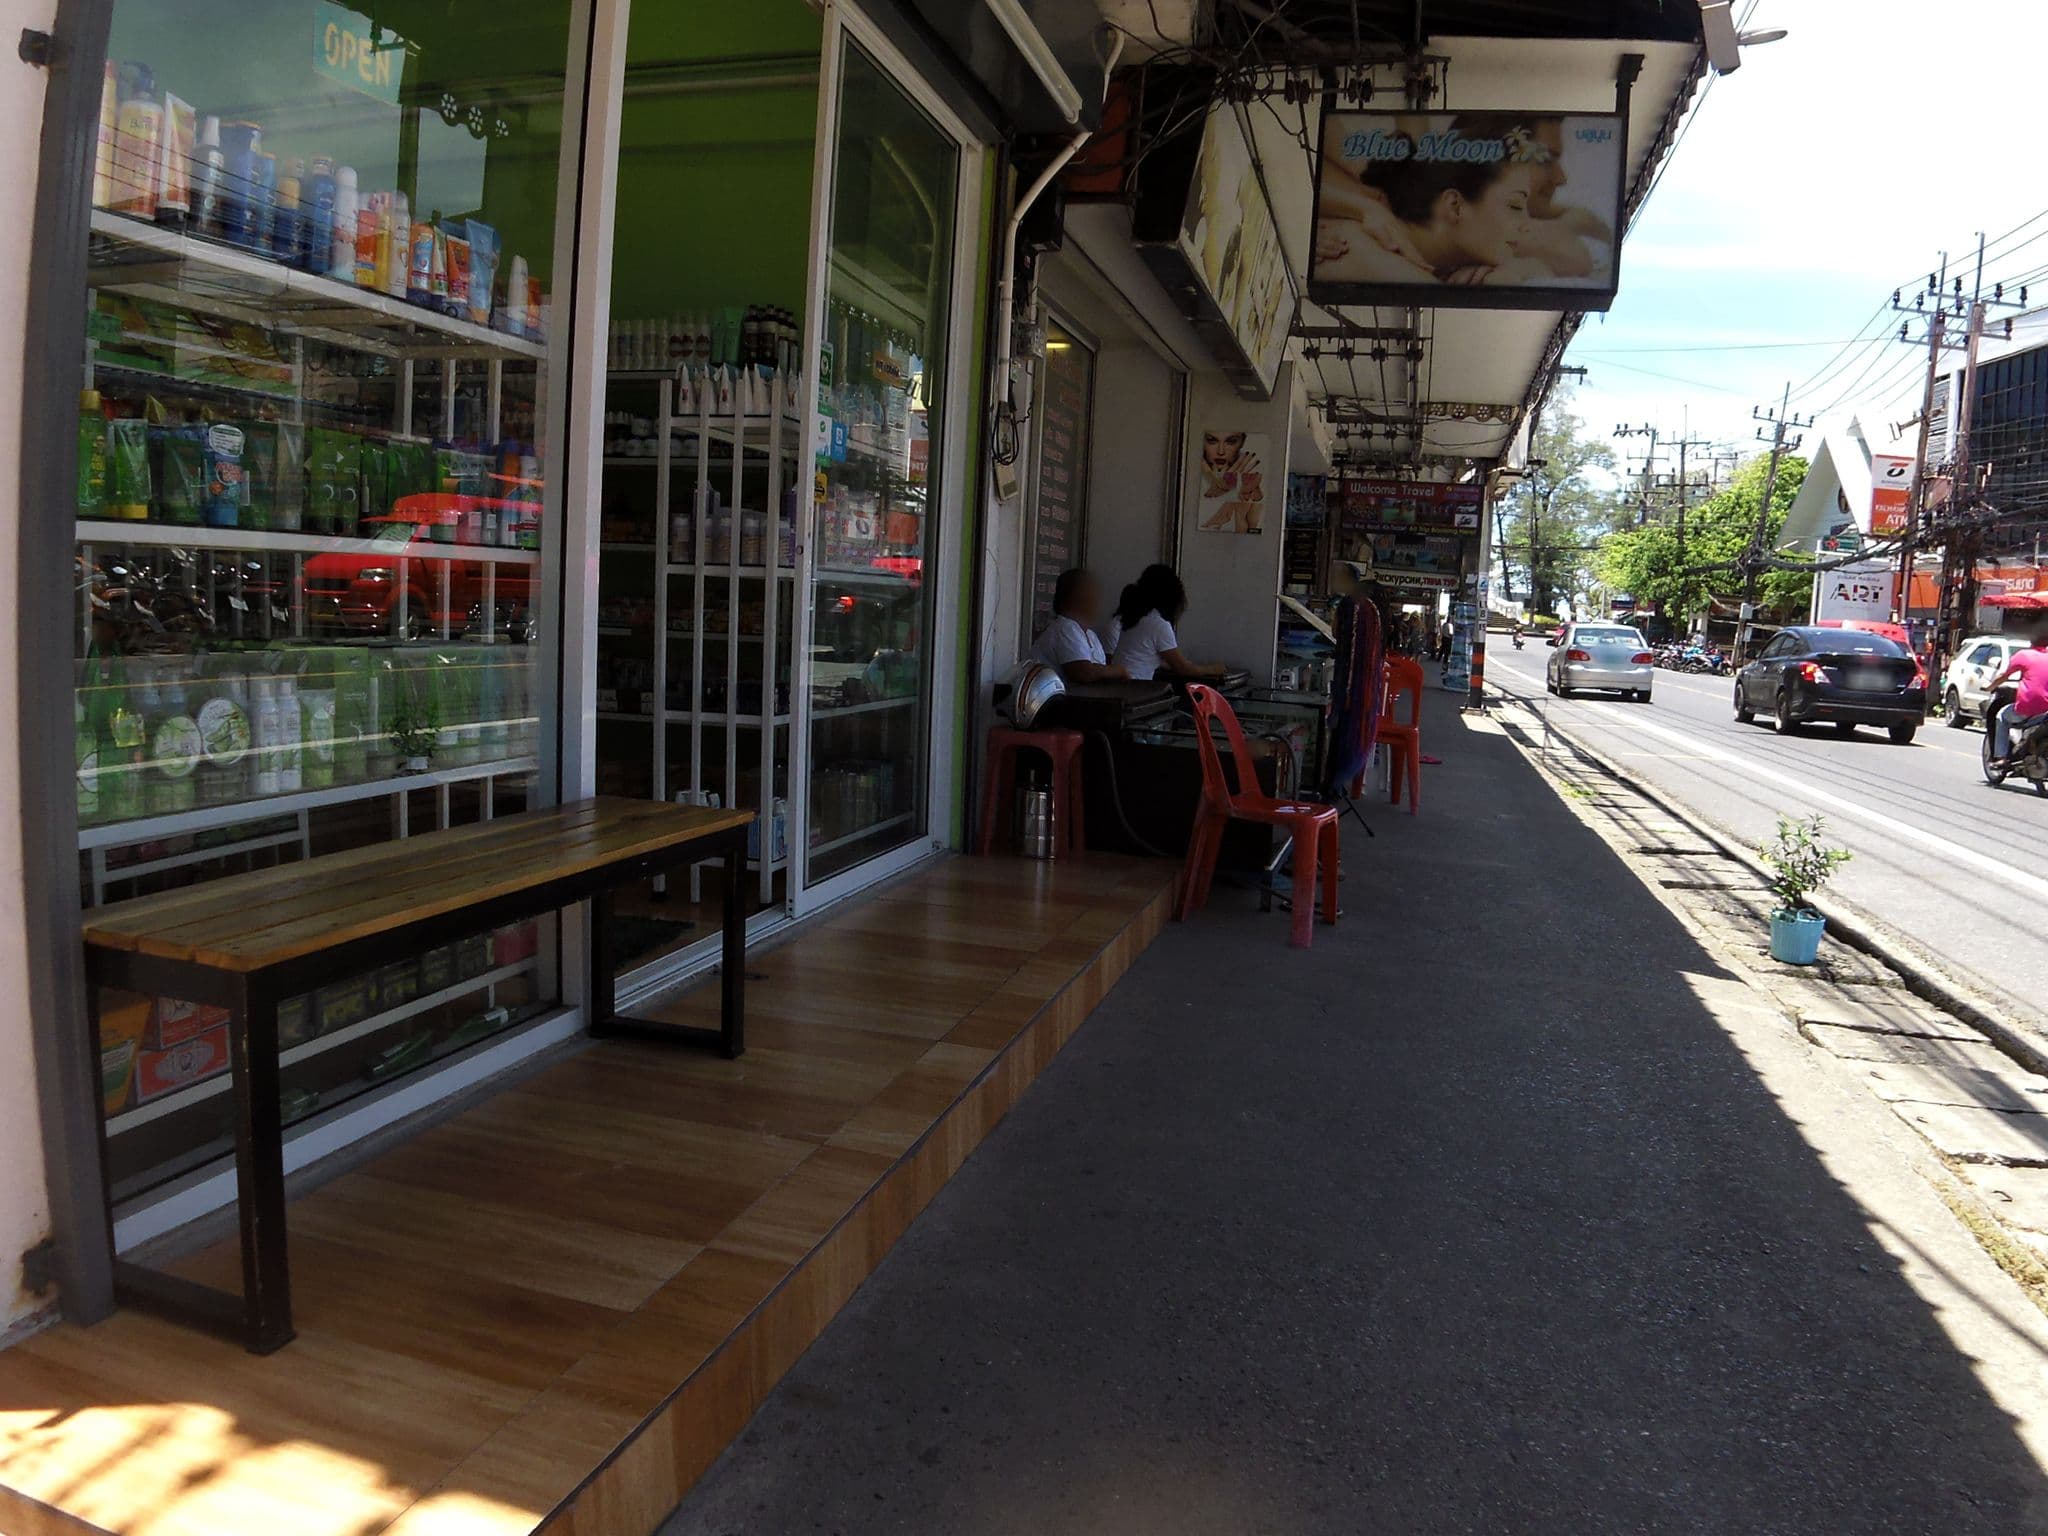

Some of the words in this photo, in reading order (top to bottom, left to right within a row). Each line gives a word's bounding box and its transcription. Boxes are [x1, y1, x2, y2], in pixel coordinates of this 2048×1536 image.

[324, 21, 391, 88] OPEN
[1343, 129, 1411, 161] Blue
[1416, 132, 1504, 162] Moon
[1350, 482, 1397, 497] Welcome
[1401, 484, 1436, 498] Travel
[1830, 583, 1884, 603] ART
